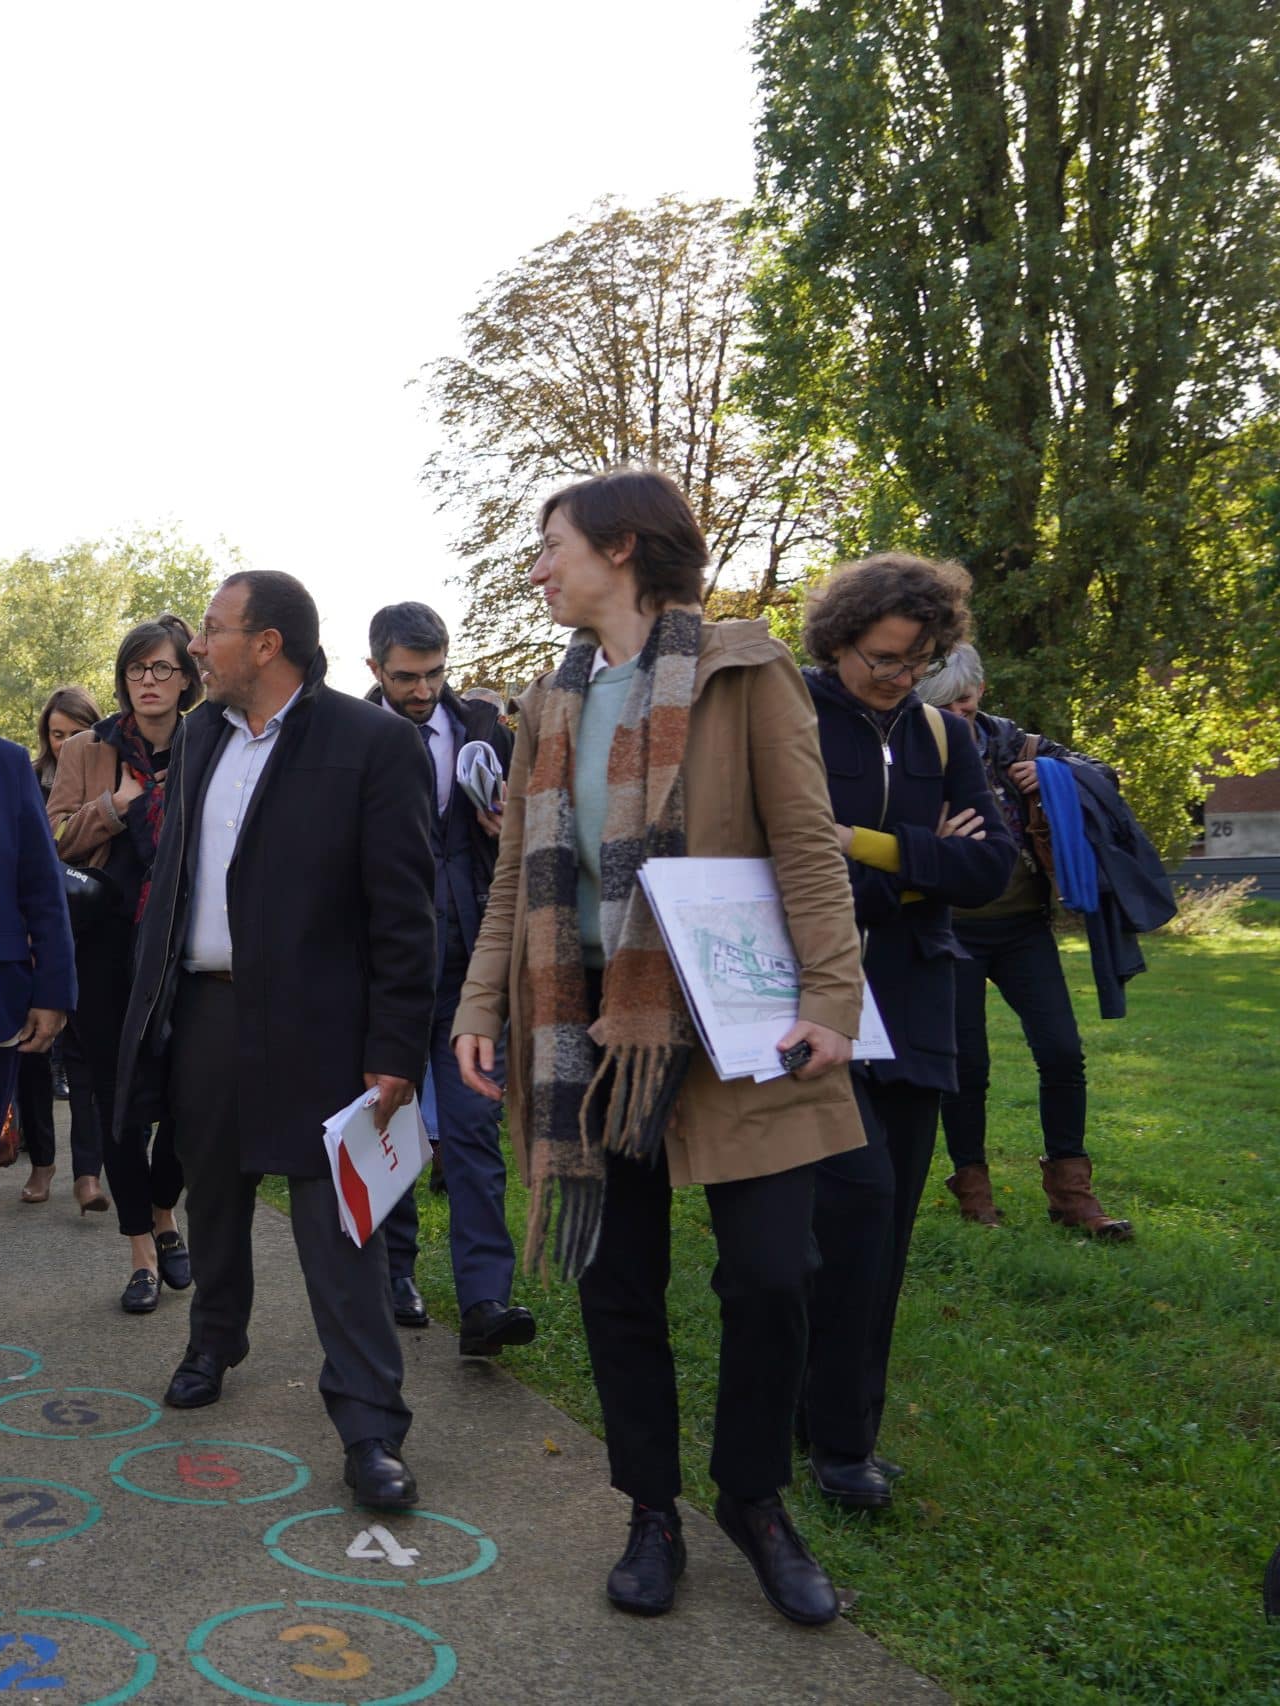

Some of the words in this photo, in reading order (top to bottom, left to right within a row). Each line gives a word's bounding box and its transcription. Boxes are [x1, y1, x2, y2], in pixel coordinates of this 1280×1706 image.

[1211, 821, 1233, 837] 26
[41, 1400, 99, 1425] 6
[176, 1453, 242, 1489] 5
[345, 1525, 420, 1567] 4
[278, 1624, 372, 1681] 3
